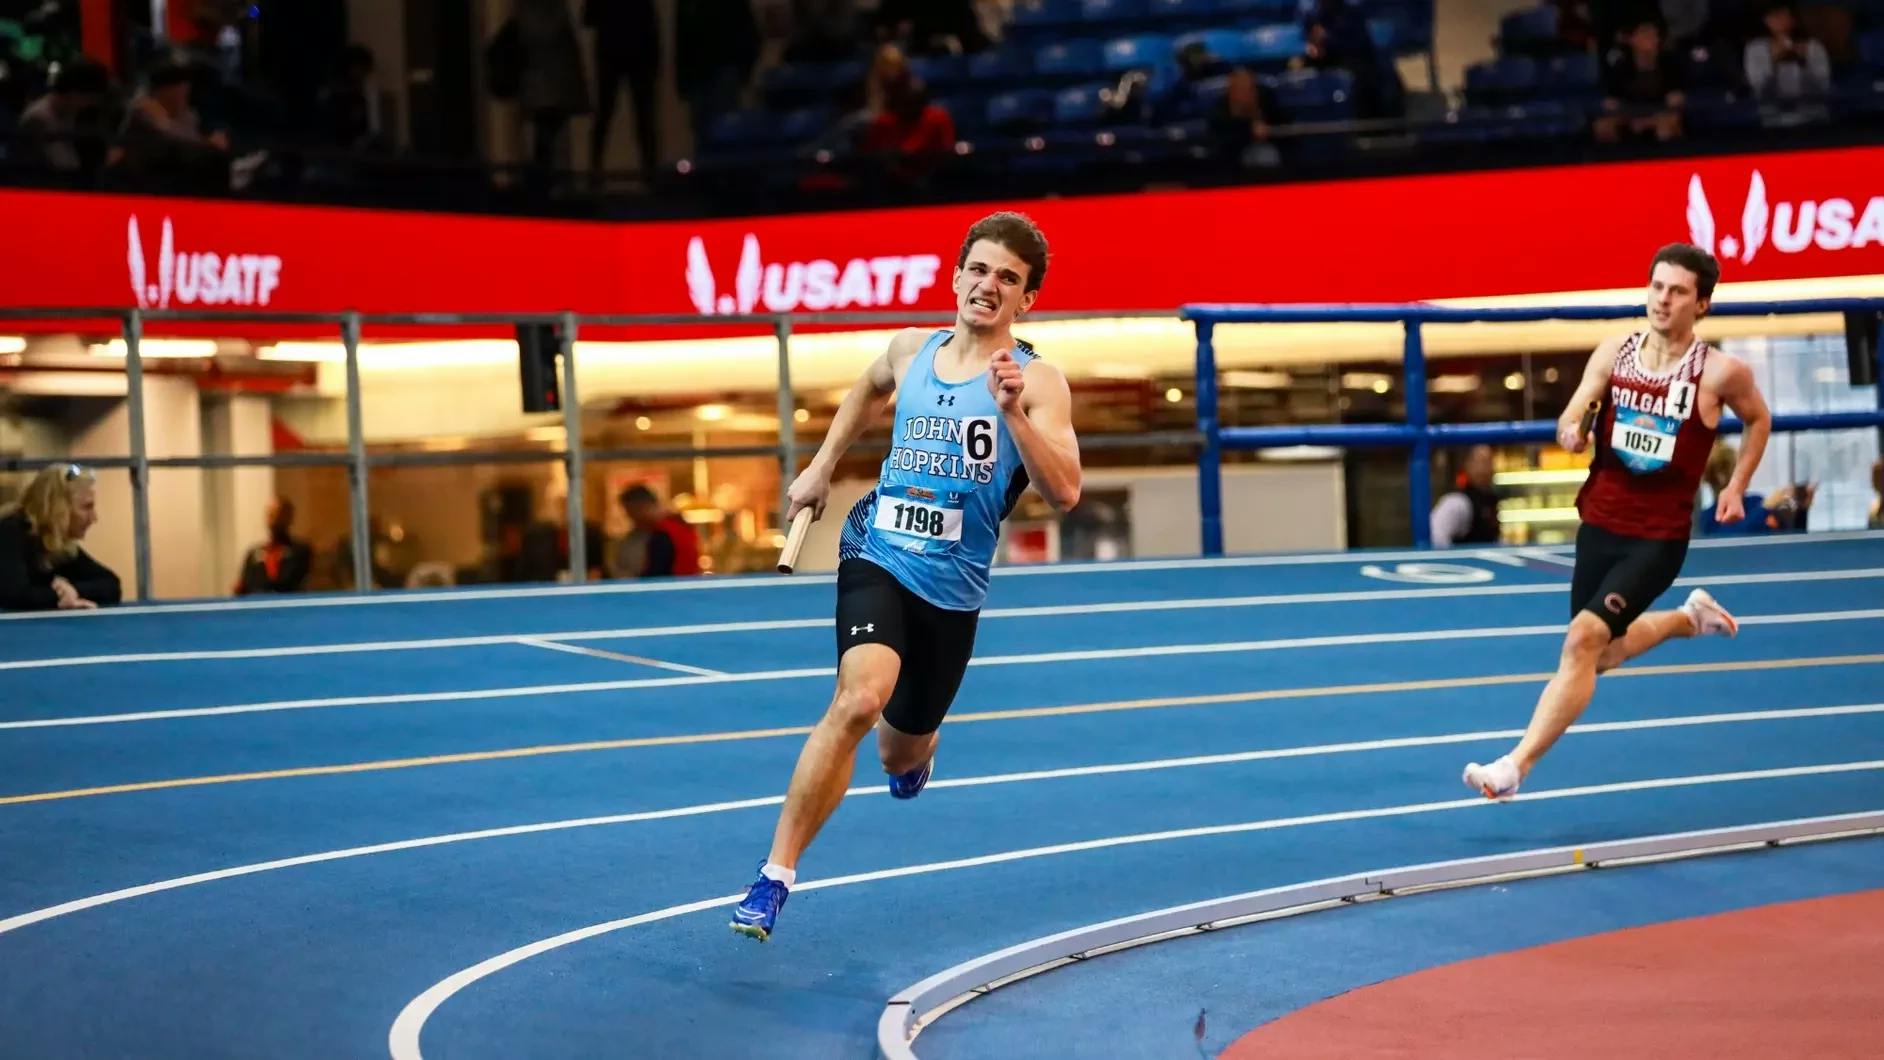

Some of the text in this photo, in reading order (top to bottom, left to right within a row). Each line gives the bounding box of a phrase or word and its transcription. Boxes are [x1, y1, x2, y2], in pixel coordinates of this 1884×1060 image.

[175, 251, 282, 305] USATF
[764, 254, 941, 312] USATF
[1611, 385, 1665, 417] COLGA
[1673, 386, 1689, 414] 4
[903, 415, 963, 446] JOHN
[966, 419, 993, 461] 6
[1624, 431, 1663, 454] 1057
[890, 446, 995, 484] HOPKINS
[894, 503, 944, 536] 1198
